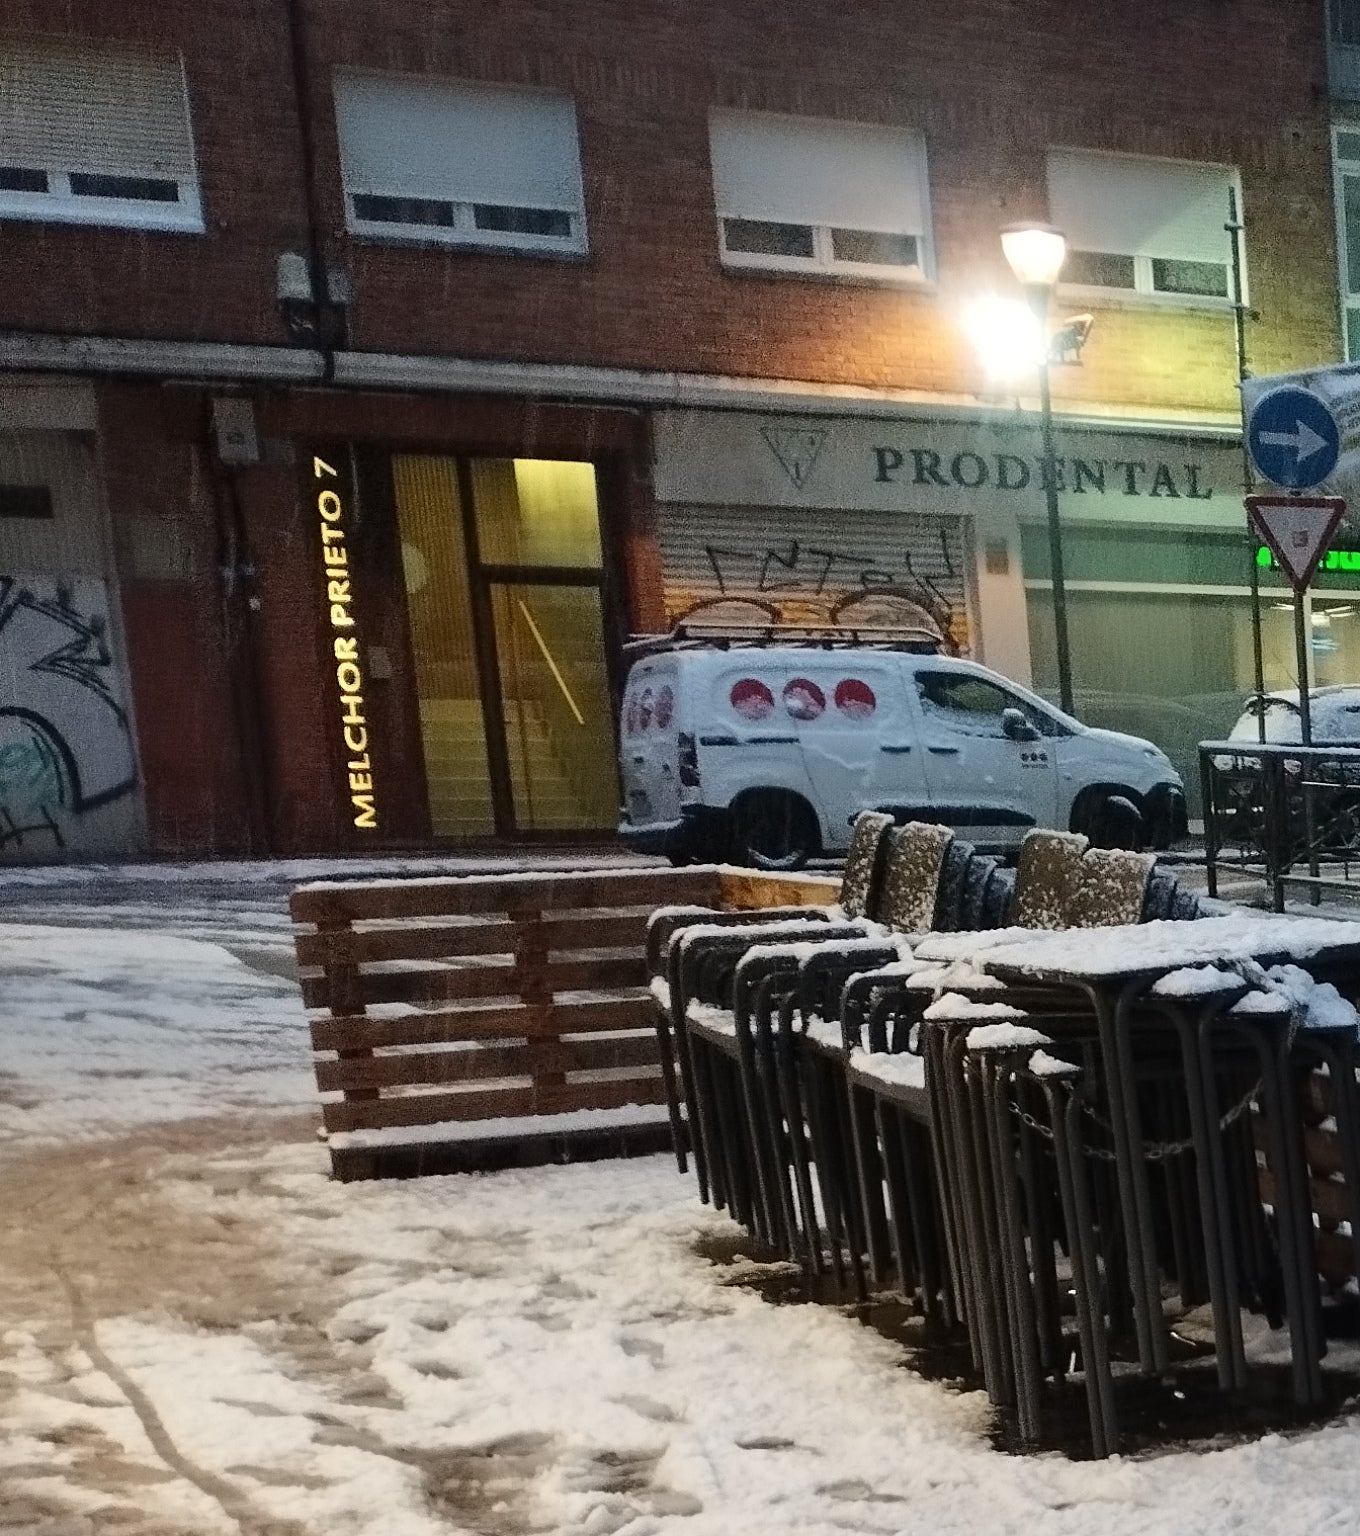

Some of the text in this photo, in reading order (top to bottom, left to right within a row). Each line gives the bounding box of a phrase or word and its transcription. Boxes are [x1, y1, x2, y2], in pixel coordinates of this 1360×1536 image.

[872, 446, 1213, 500] PRODENTAL
[313, 456, 377, 829] MELCHOR PRIETO 7
